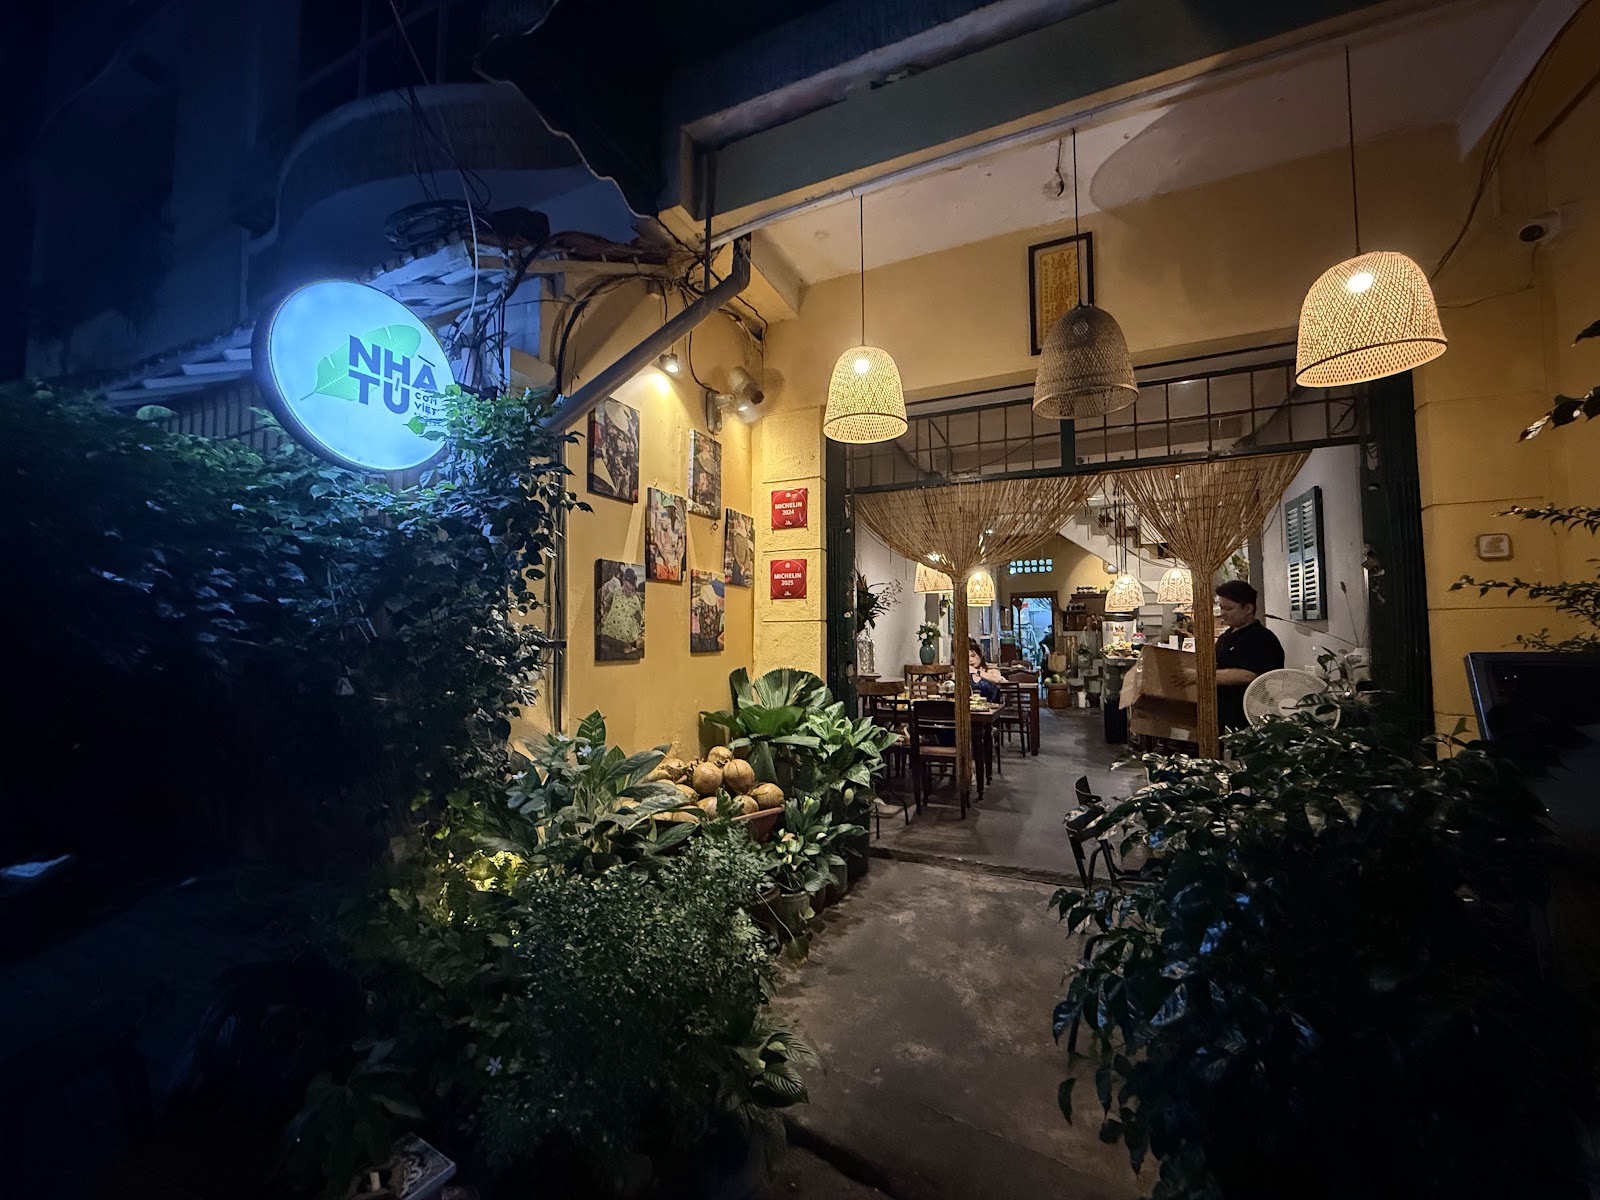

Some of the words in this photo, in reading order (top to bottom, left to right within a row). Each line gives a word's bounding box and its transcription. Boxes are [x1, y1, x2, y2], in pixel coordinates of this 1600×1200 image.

[349, 335, 437, 391] NHÀ
[774, 501, 803, 510] MICHELIN
[773, 572, 802, 580] MICHELIN
